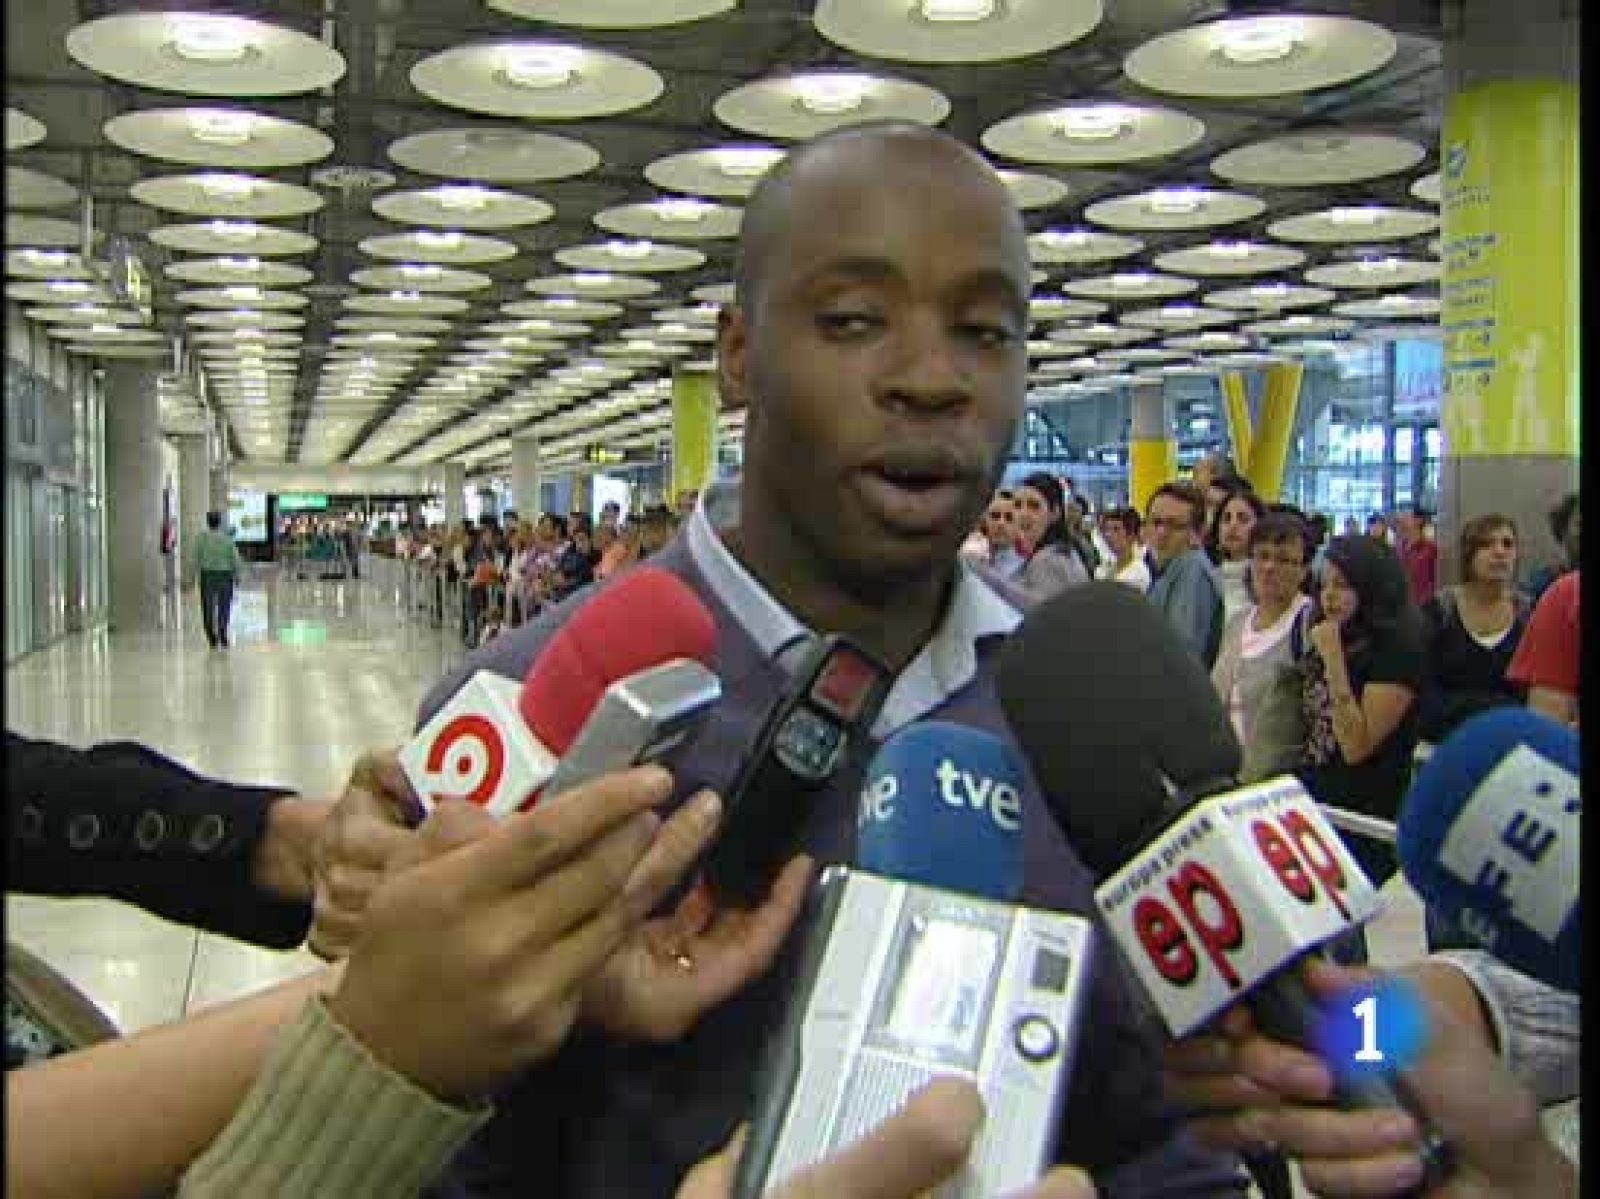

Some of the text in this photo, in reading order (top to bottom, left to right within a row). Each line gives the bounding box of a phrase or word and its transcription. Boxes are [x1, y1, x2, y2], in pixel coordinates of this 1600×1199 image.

[936, 760, 1022, 830] tve
[1162, 816, 1213, 869] press
[1252, 808, 1350, 921] ep
[1133, 859, 1244, 988] ep
